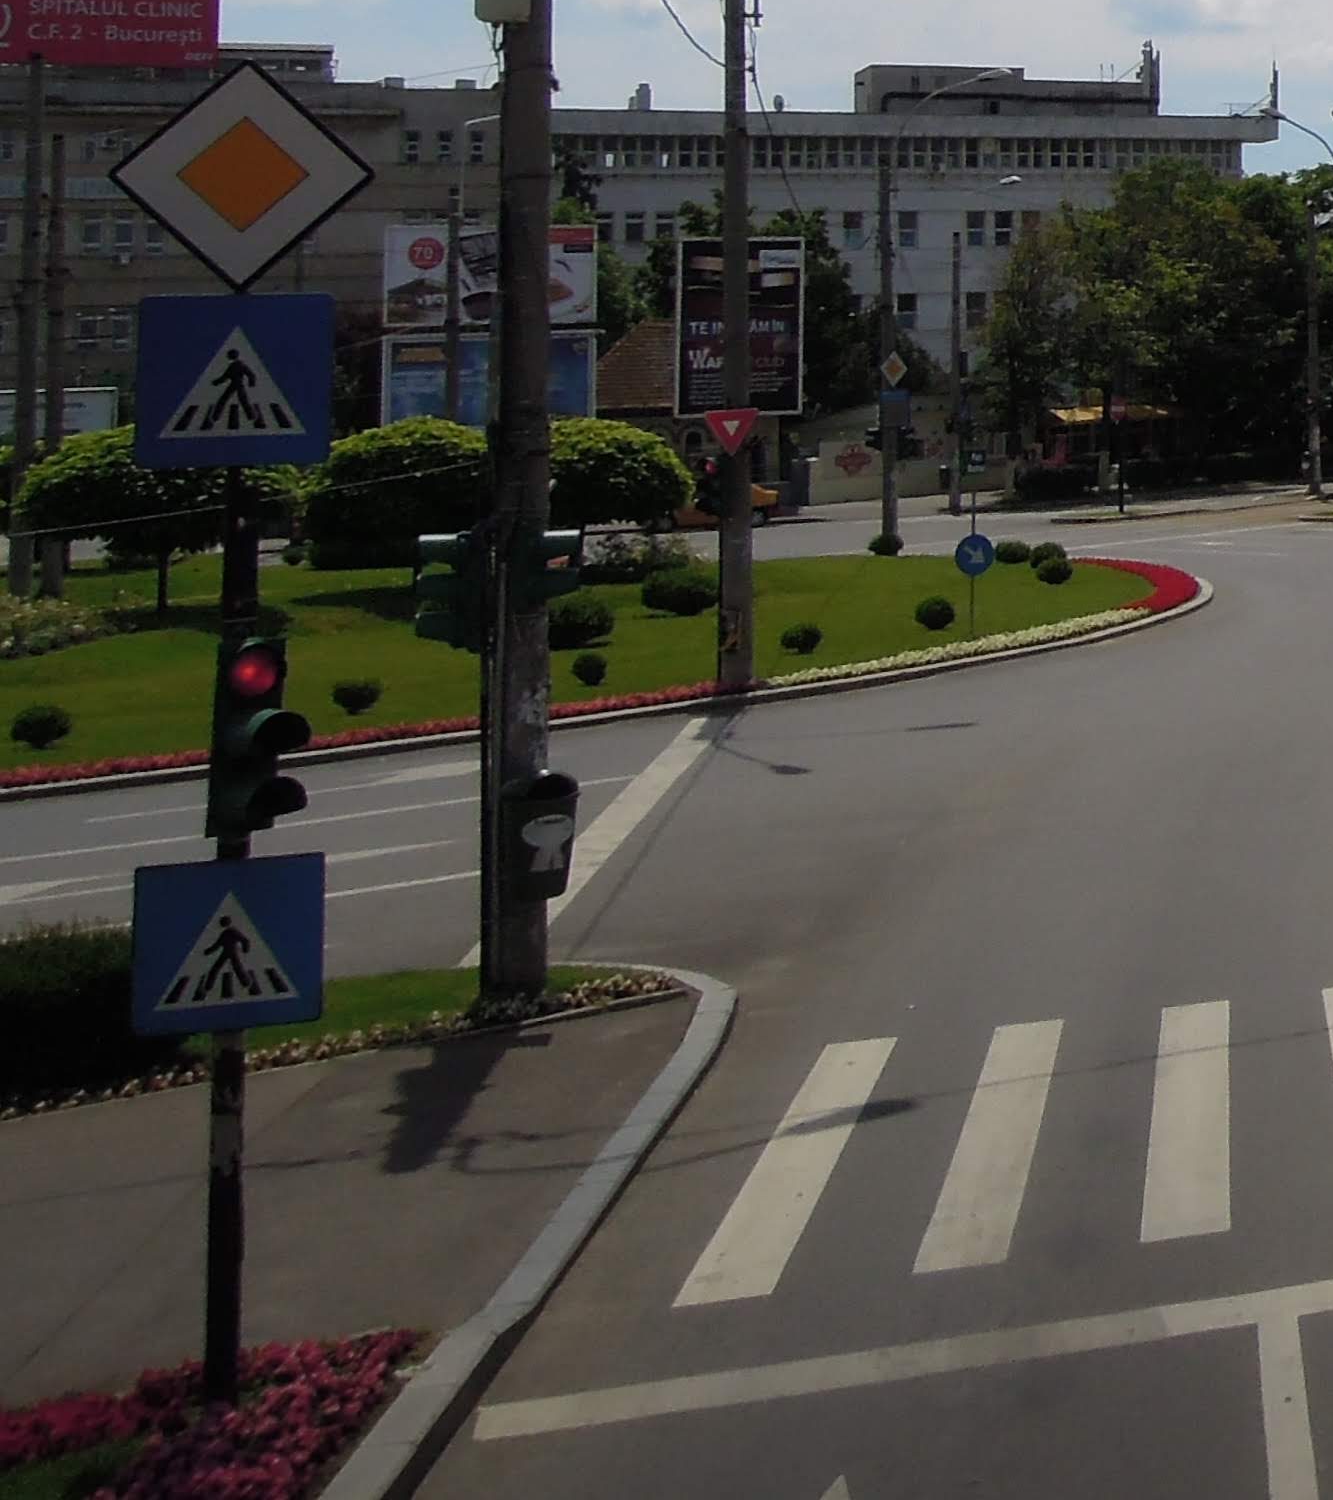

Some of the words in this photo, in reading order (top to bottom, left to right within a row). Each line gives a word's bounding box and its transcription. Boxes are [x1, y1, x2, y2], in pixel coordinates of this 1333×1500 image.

[133, 1, 204, 18] CLINIC
[27, 23, 63, 40] C.F.
[70, 25, 82, 40] 2
[413, 245, 434, 259] 70
[688, 322, 710, 336] TE
